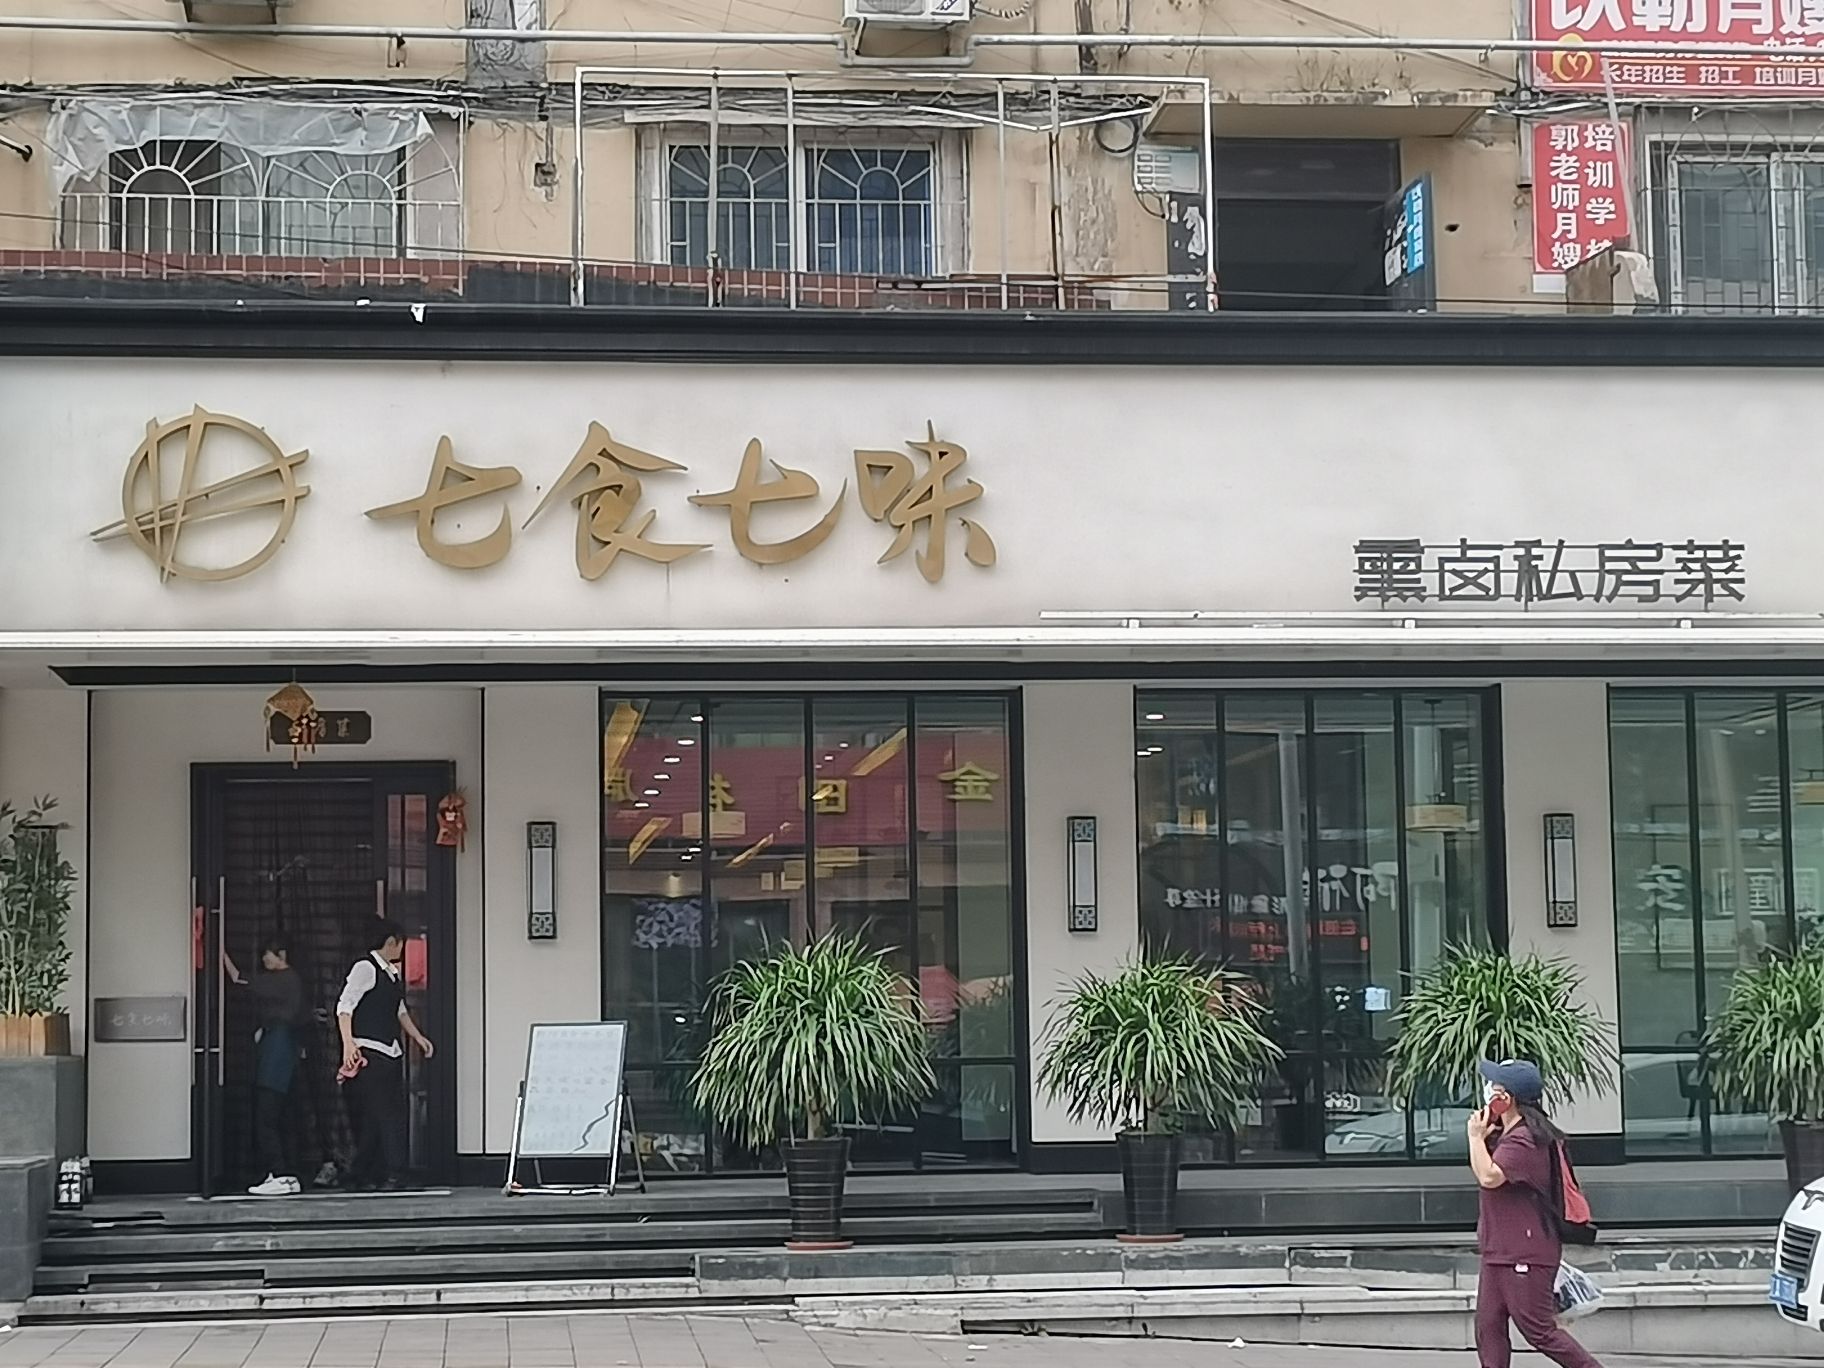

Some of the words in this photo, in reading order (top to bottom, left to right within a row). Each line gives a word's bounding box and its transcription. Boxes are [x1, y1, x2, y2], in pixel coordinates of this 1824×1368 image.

[1601, 64, 1687, 85] 长年招生
[1699, 66, 1742, 85] 招工
[1549, 124, 1581, 270] 郭老师月嫂
[363, 420, 996, 583] 七食七味
[1353, 537, 1746, 612] 熏卤私房菜
